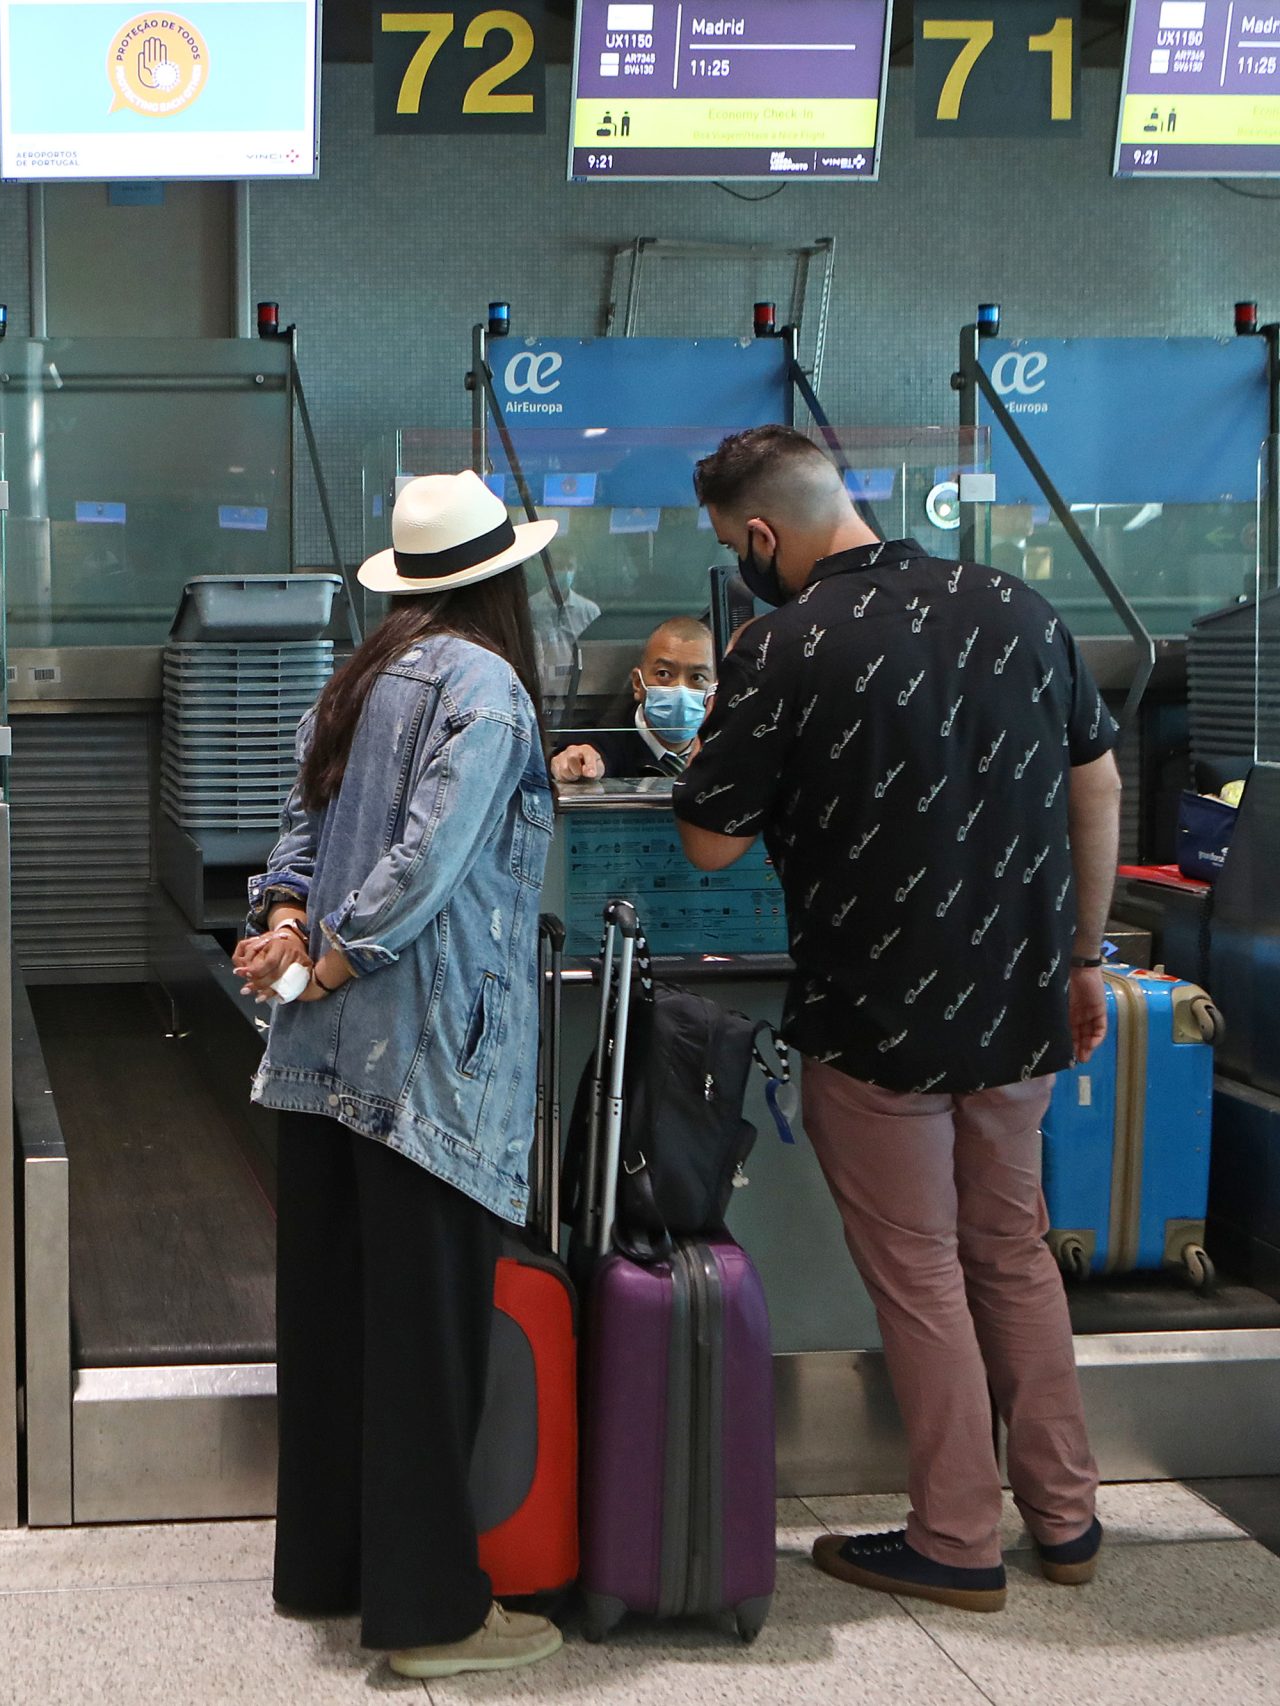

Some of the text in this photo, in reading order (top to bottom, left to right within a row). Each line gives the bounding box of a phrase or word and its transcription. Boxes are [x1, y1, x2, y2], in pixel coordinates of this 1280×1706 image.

[692, 18, 745, 35] Madrid
[1241, 16, 1280, 34] Madr
[116, 19, 200, 61] PROTEÇÃO DE TODOS
[606, 34, 653, 49] UX1150
[1157, 31, 1204, 46] UX1150
[381, 10, 535, 115] 72
[690, 59, 730, 77] 11:25
[1238, 56, 1277, 75] 11:25
[708, 108, 759, 121] Economy
[16, 151, 78, 159] AEROPORTOS
[16, 158, 80, 167] DE PORTUGAL
[588, 155, 613, 169] 9:21
[1134, 150, 1159, 165] 9:21
[505, 401, 564, 416] AirEuropa
